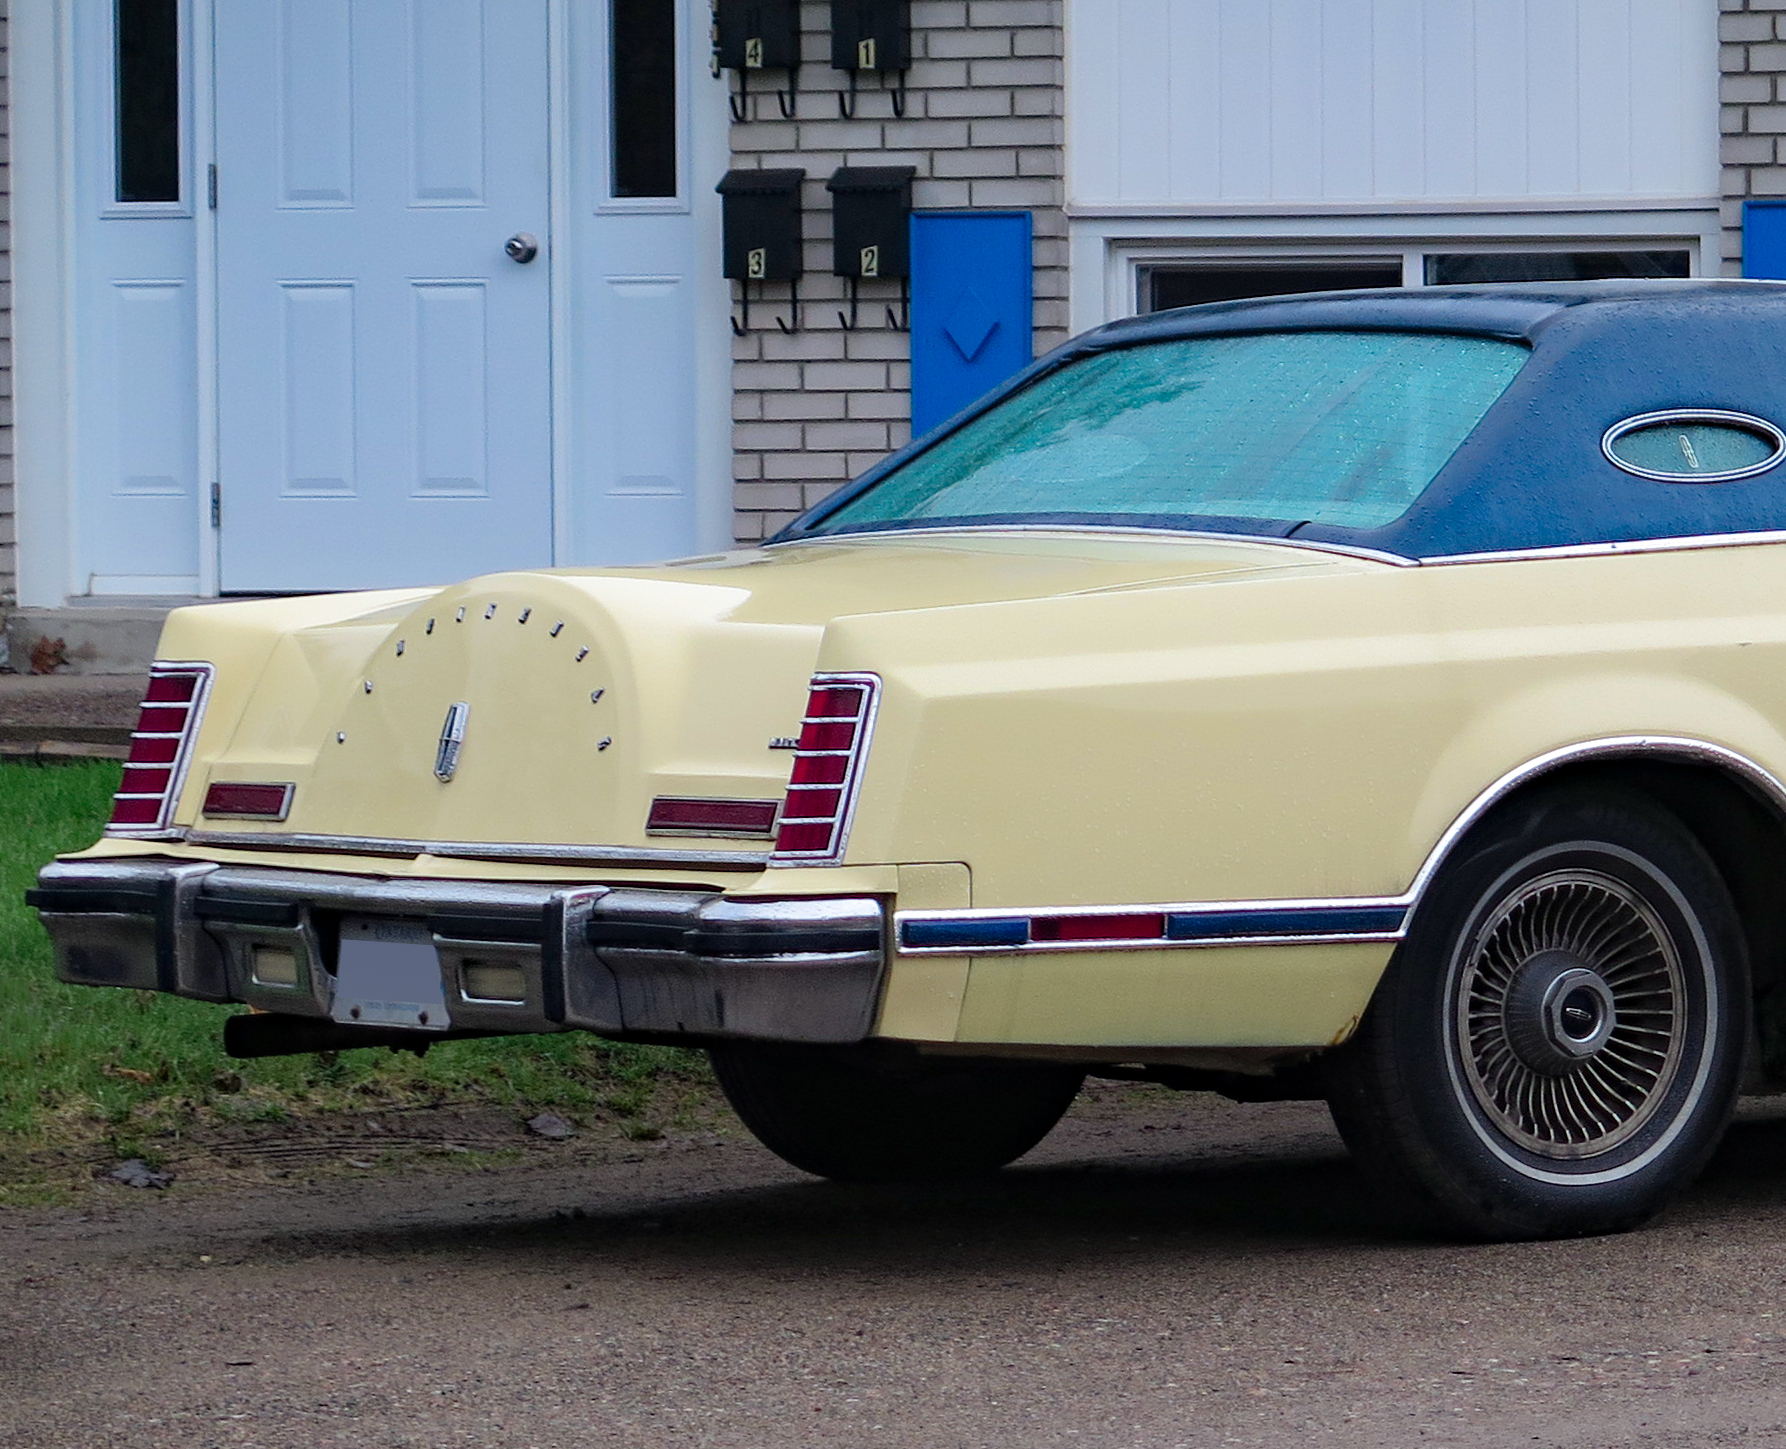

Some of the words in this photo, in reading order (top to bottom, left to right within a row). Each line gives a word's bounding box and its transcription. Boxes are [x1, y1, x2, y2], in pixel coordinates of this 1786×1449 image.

[747, 39, 760, 63] 4
[862, 41, 871, 65] 1
[751, 251, 762, 275] 3
[864, 248, 875, 273] 2
